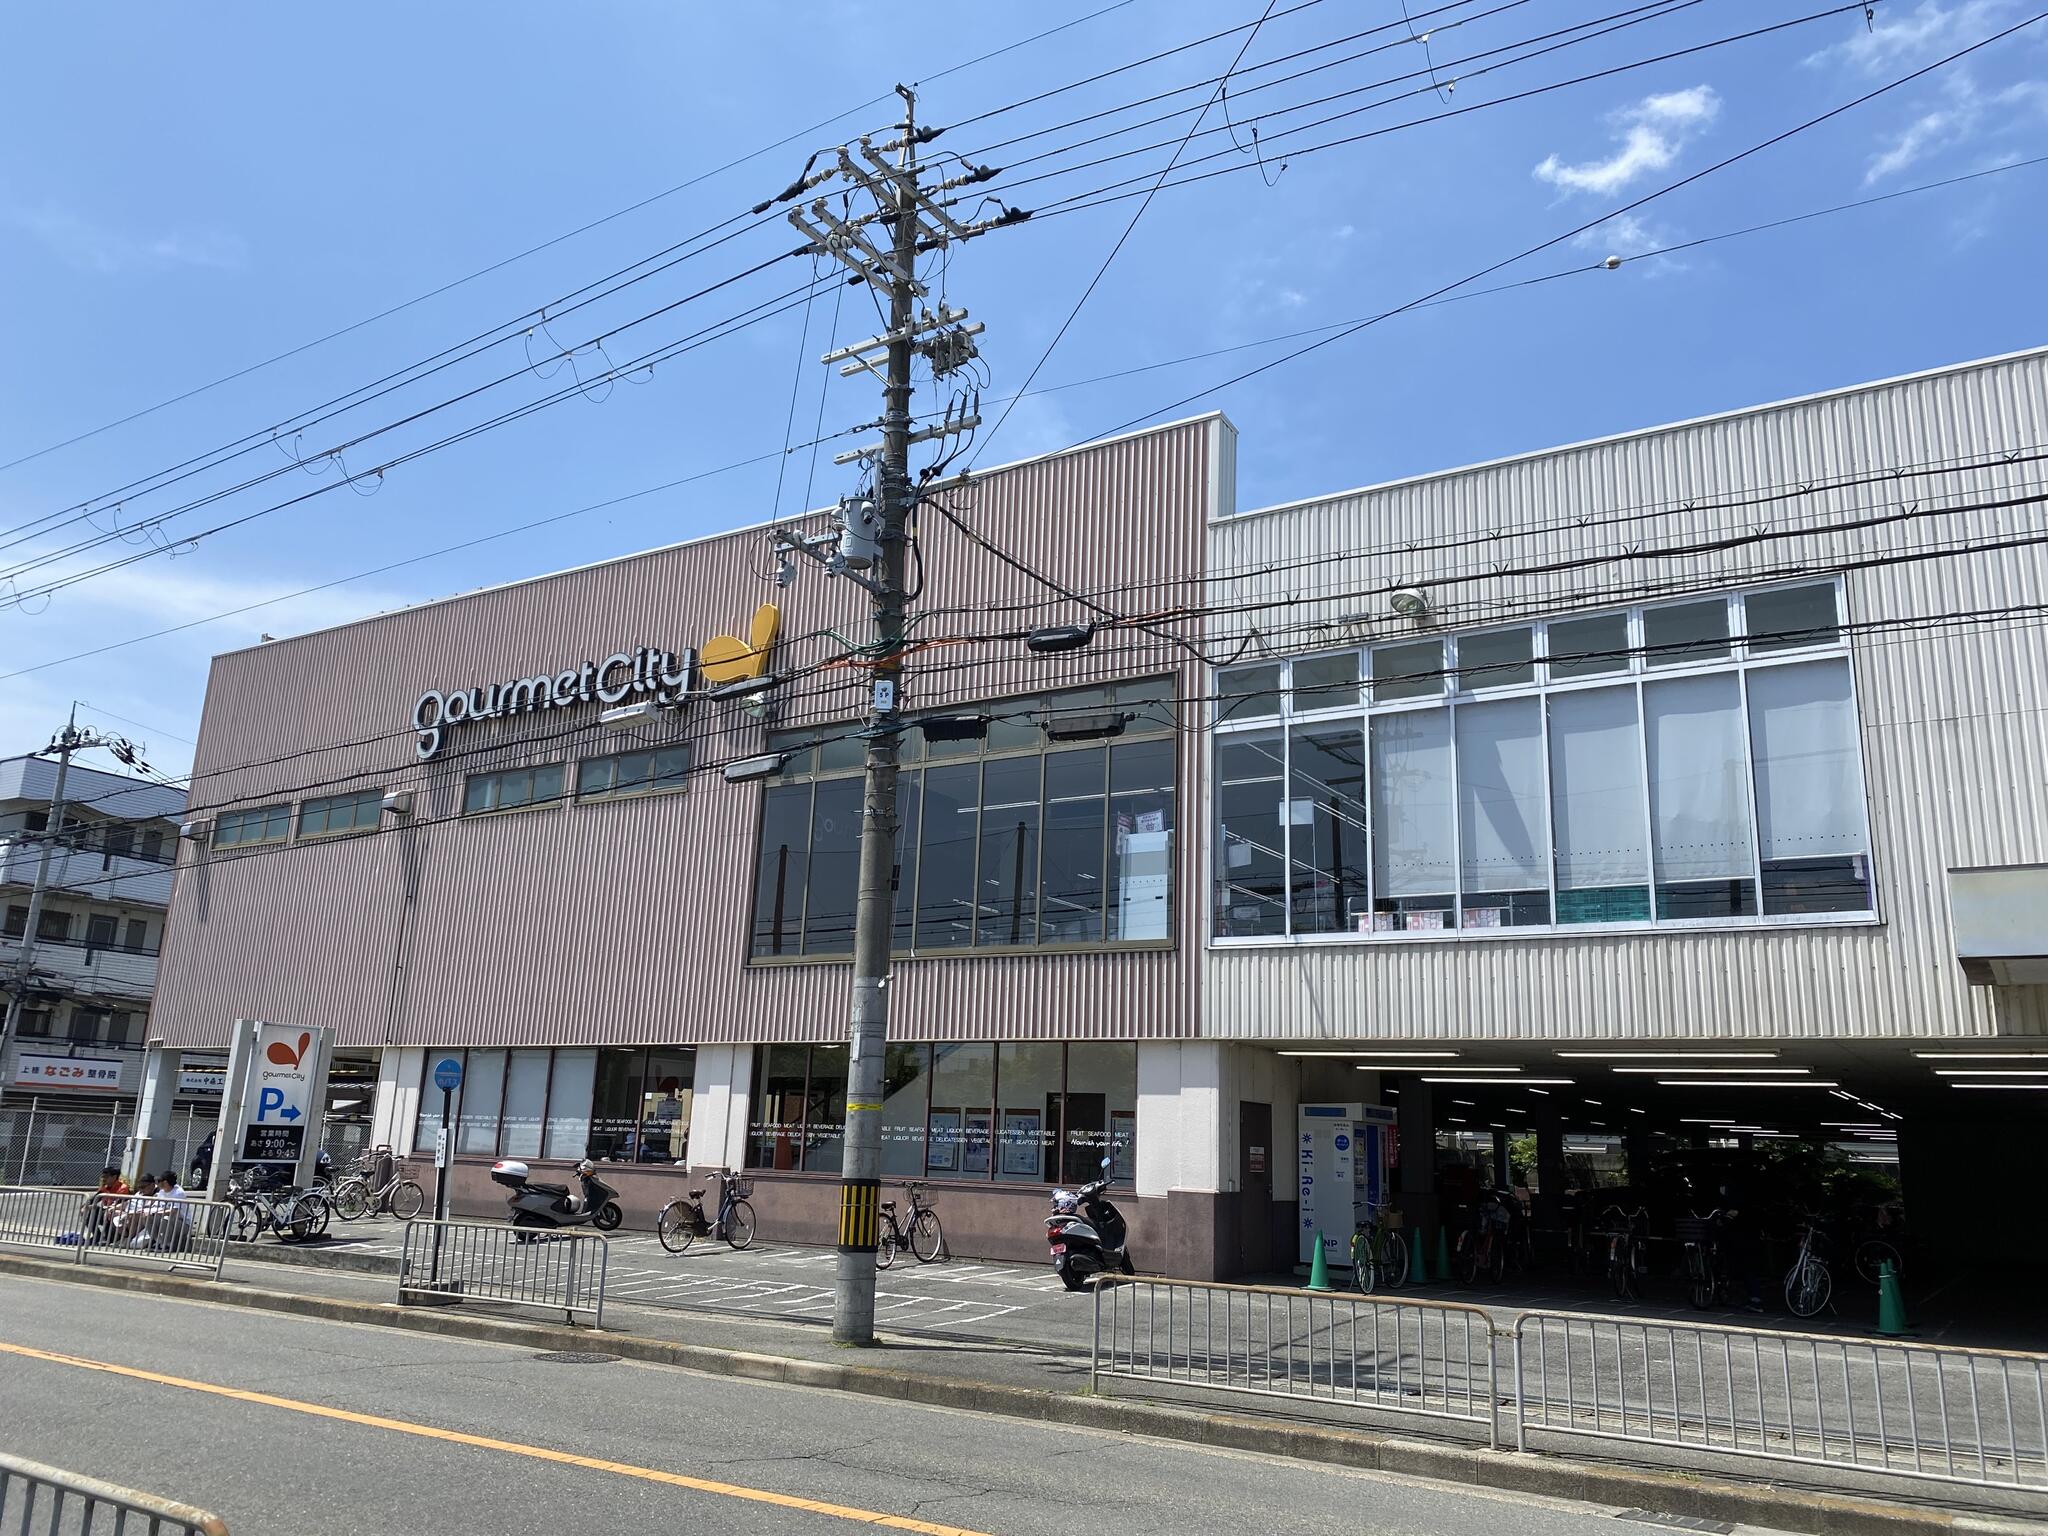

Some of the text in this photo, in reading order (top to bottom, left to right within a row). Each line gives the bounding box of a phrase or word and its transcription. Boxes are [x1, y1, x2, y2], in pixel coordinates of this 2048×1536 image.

[412, 645, 694, 760] gourmetCity
[44, 1065, 84, 1078] なごみ
[87, 1069, 117, 1079] 整骨院
[263, 1071, 305, 1081] gourmetCity
[257, 1087, 284, 1122] P
[260, 1129, 290, 1137] 営業時間
[265, 1139, 285, 1148] 9:00
[276, 1149, 295, 1158] 9:45
